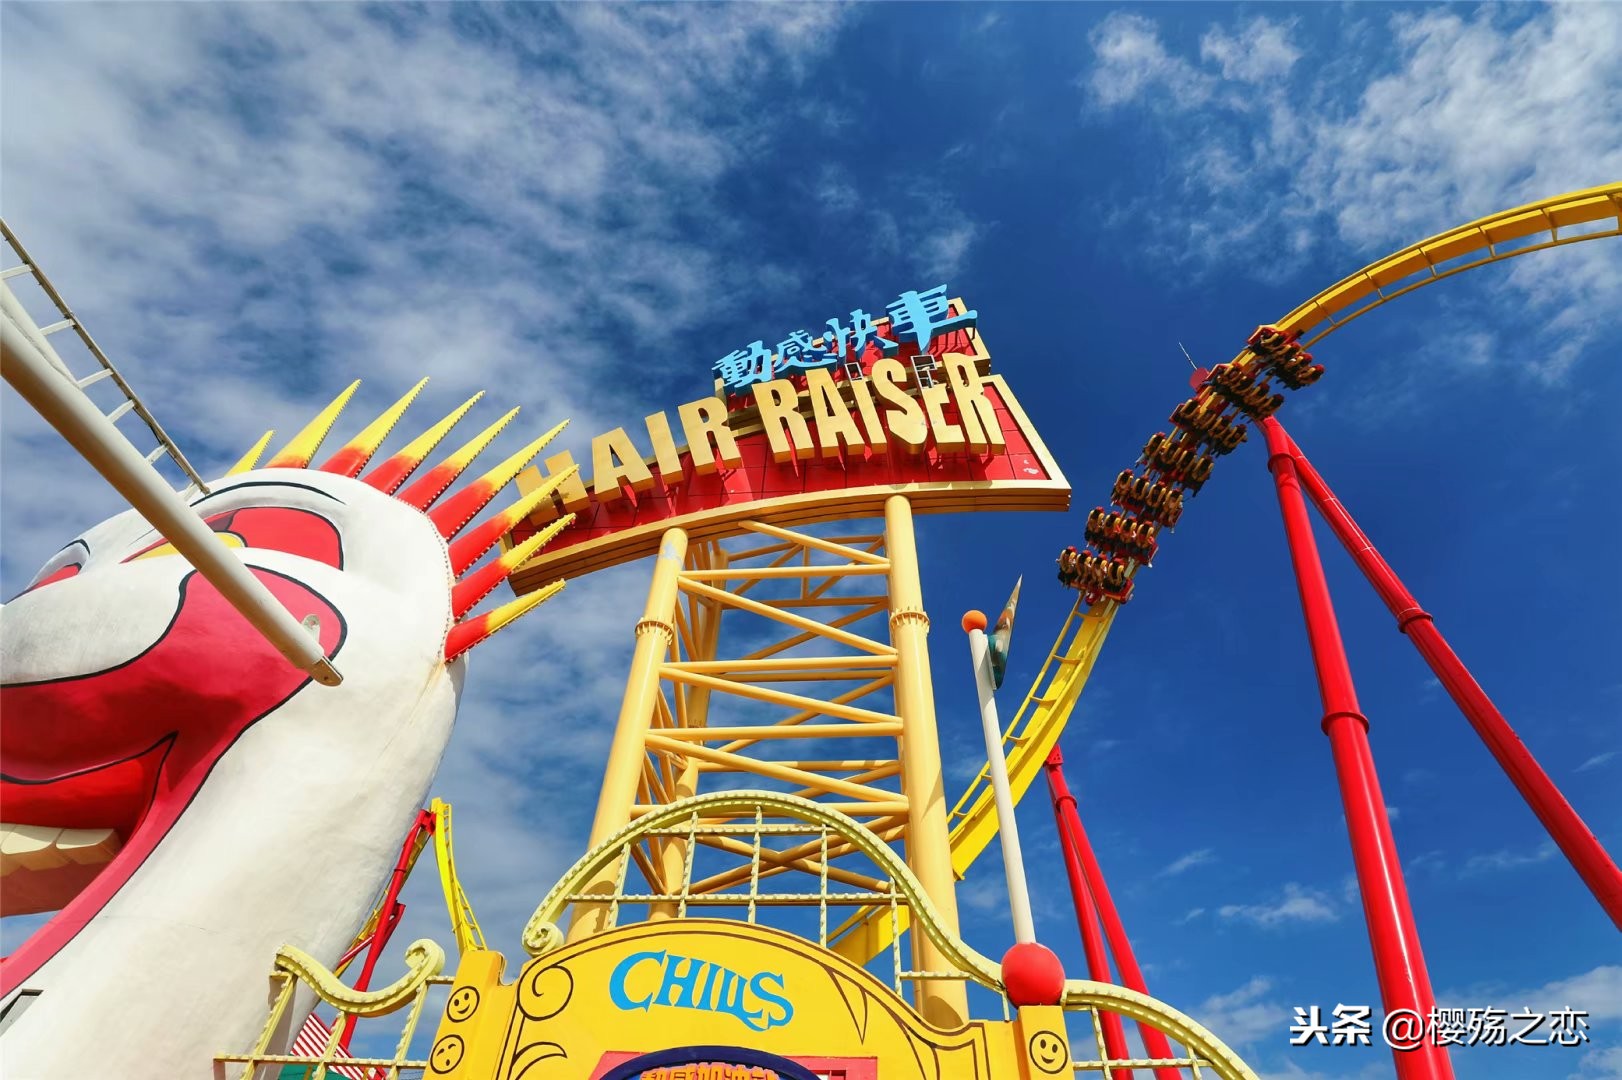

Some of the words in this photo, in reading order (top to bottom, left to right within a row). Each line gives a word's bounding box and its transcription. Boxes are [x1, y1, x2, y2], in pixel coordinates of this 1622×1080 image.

[712, 284, 978, 393] 動感快車
[515, 396, 742, 522] HAIR
[752, 353, 1006, 459] RAISER
